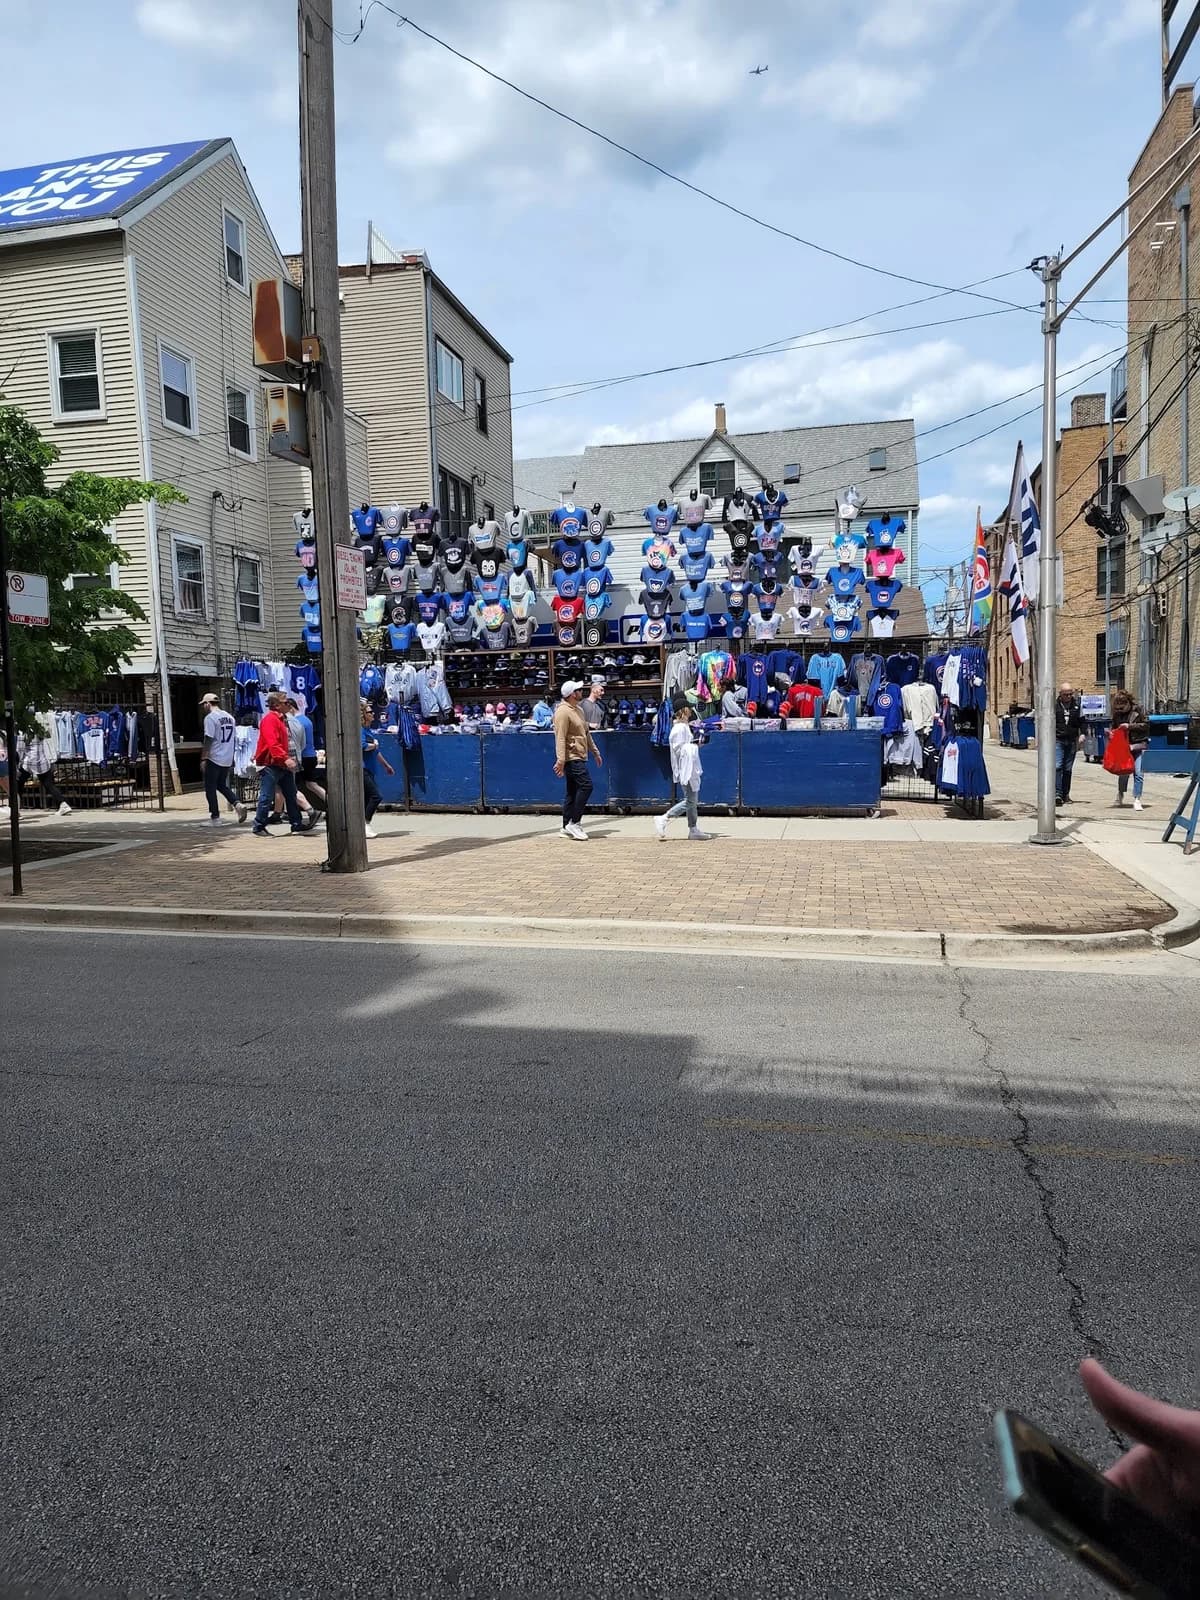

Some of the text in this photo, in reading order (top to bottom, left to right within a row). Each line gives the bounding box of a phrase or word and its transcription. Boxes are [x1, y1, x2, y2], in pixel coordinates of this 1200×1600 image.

[33, 152, 171, 184] THIS
[0, 171, 143, 202] AN'S
[11, 614, 47, 624] TOW ZONE
[296, 676, 306, 690] 8
[220, 725, 234, 744] 17
